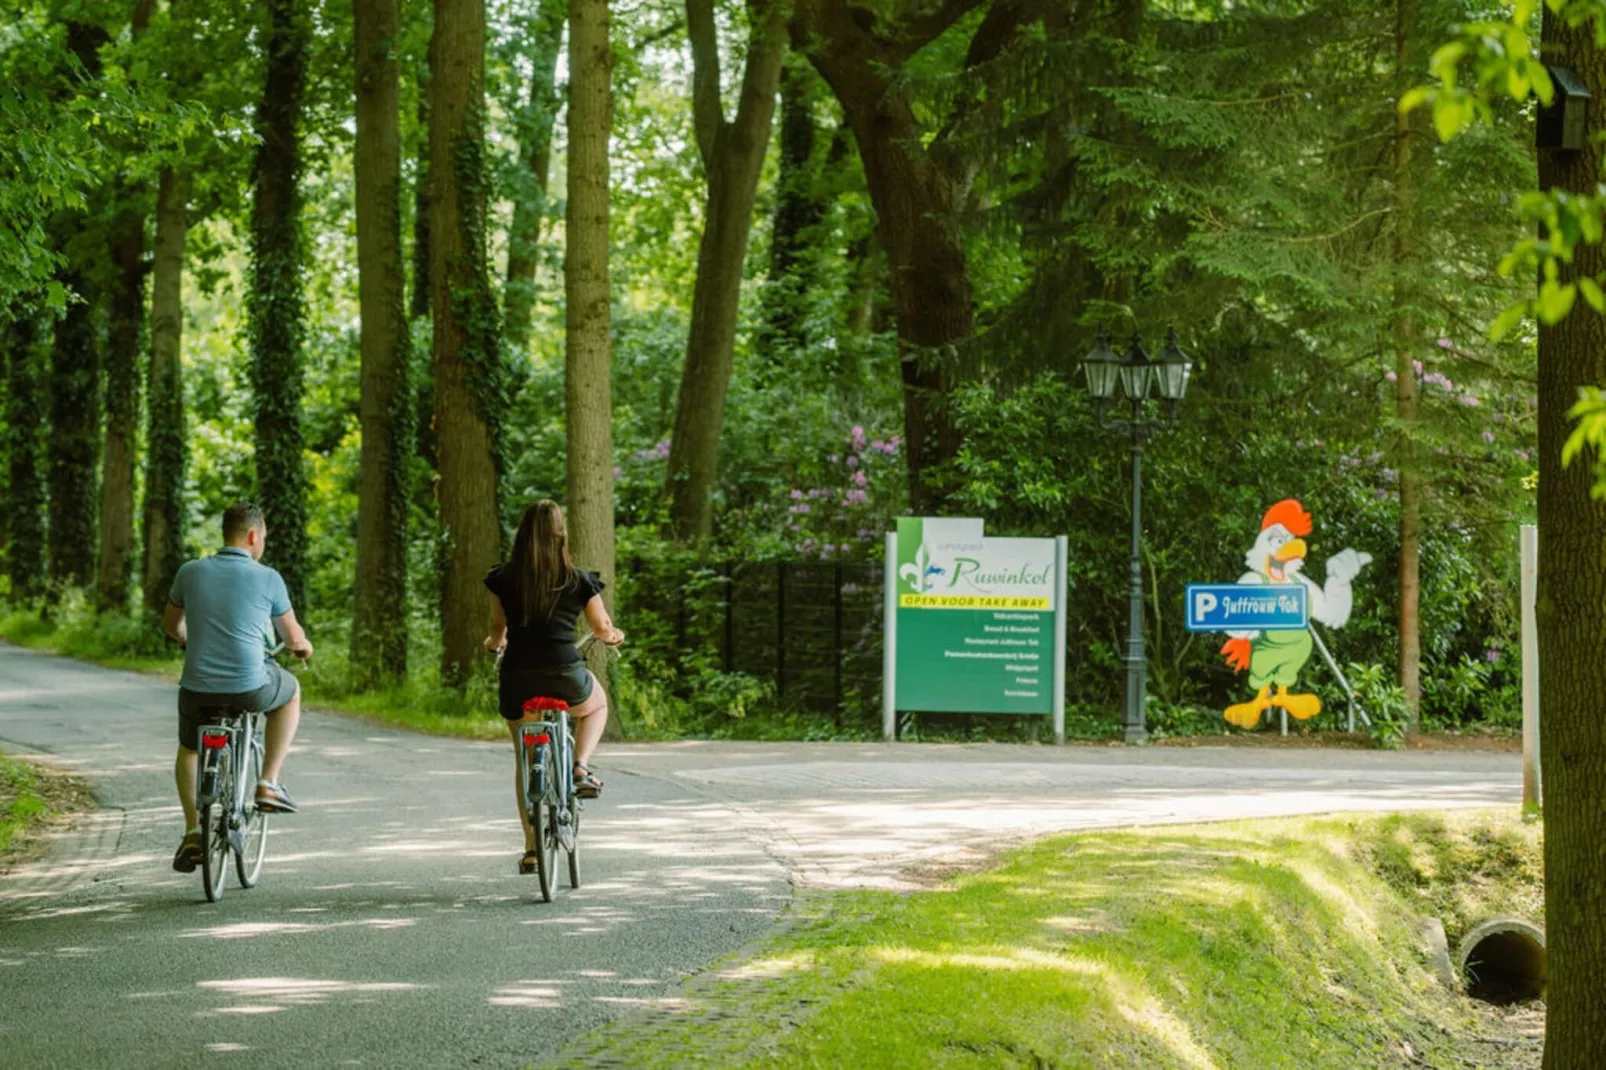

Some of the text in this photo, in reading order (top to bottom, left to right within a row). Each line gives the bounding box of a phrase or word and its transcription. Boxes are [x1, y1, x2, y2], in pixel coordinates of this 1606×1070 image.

[946, 557, 1053, 594] Ruwinkel
[904, 595, 1046, 608] OPEN VOOR TAKE AWAY
[1195, 592, 1299, 622] P Juffrouw Tok
